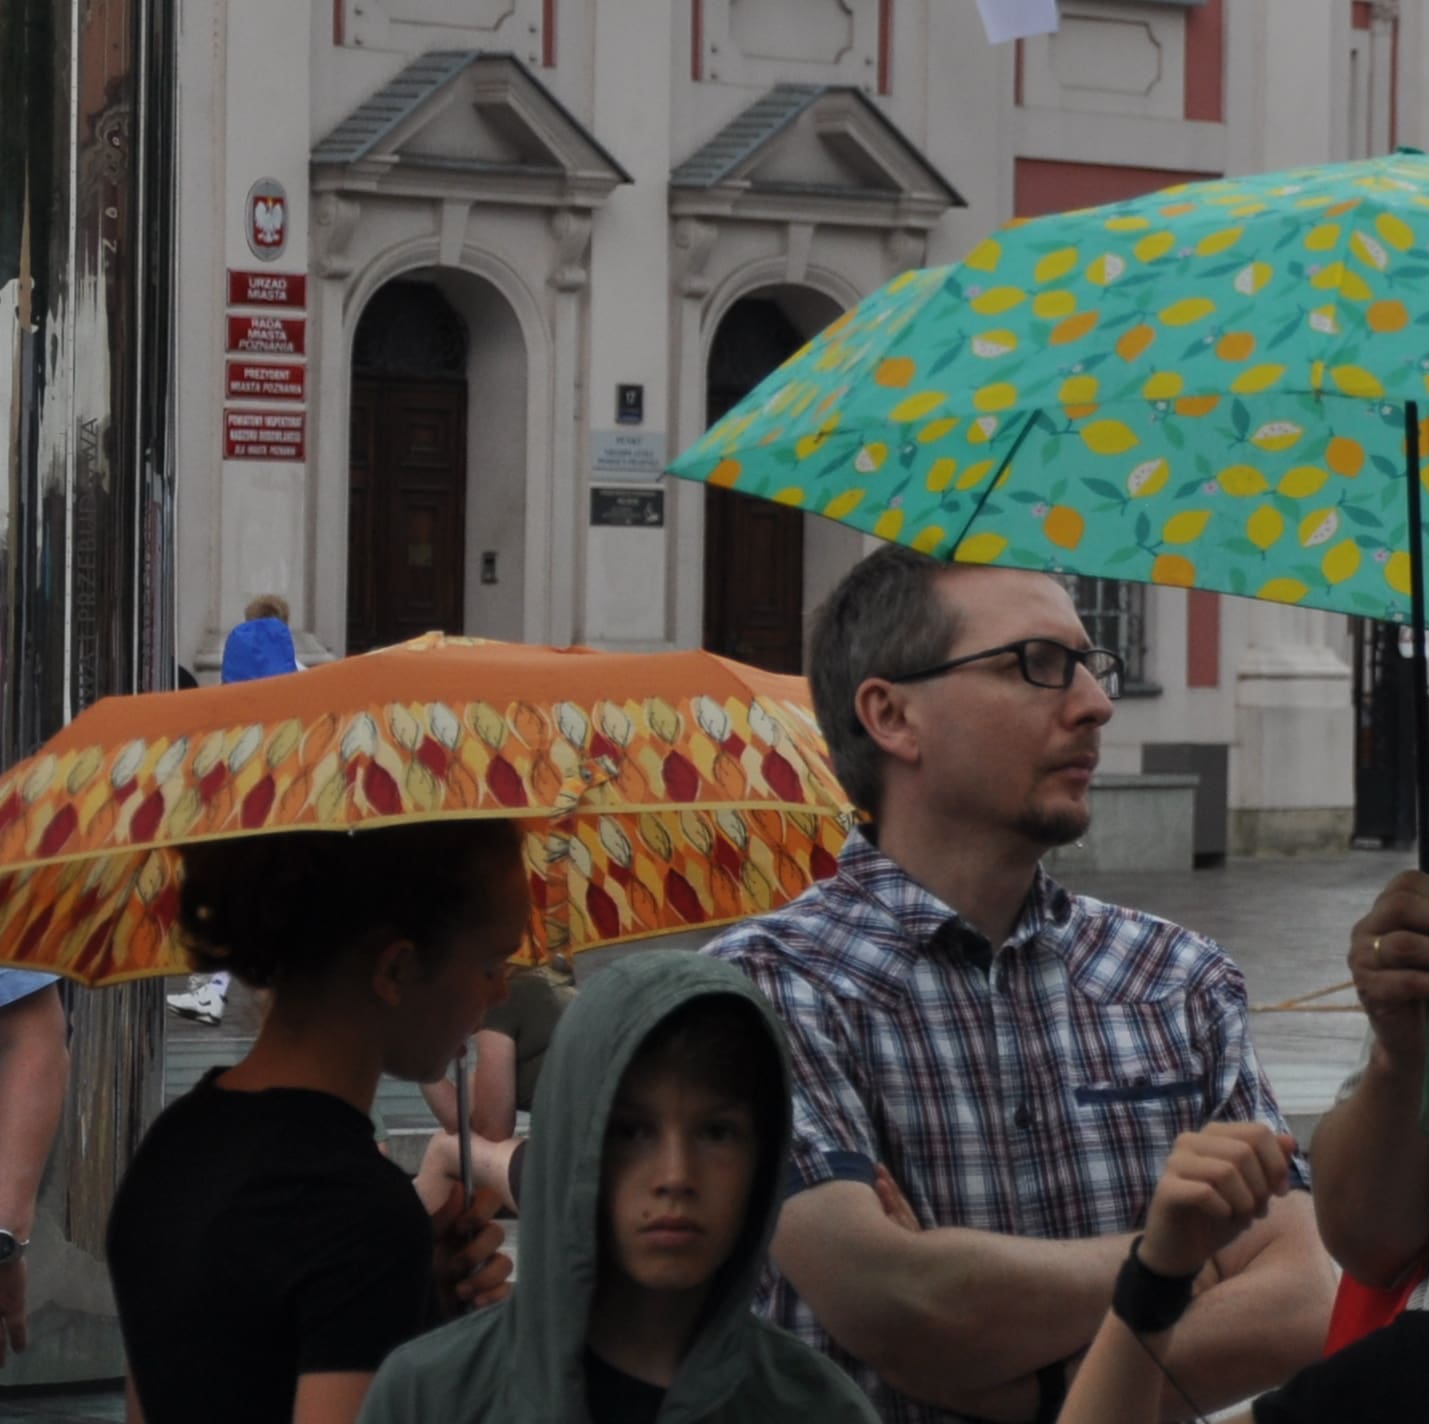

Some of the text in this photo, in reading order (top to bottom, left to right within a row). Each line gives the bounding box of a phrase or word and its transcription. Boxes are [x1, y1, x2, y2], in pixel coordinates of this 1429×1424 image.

[247, 289, 287, 301] MIASTA
[251, 318, 282, 329] RADA
[247, 329, 287, 341] MIASTA
